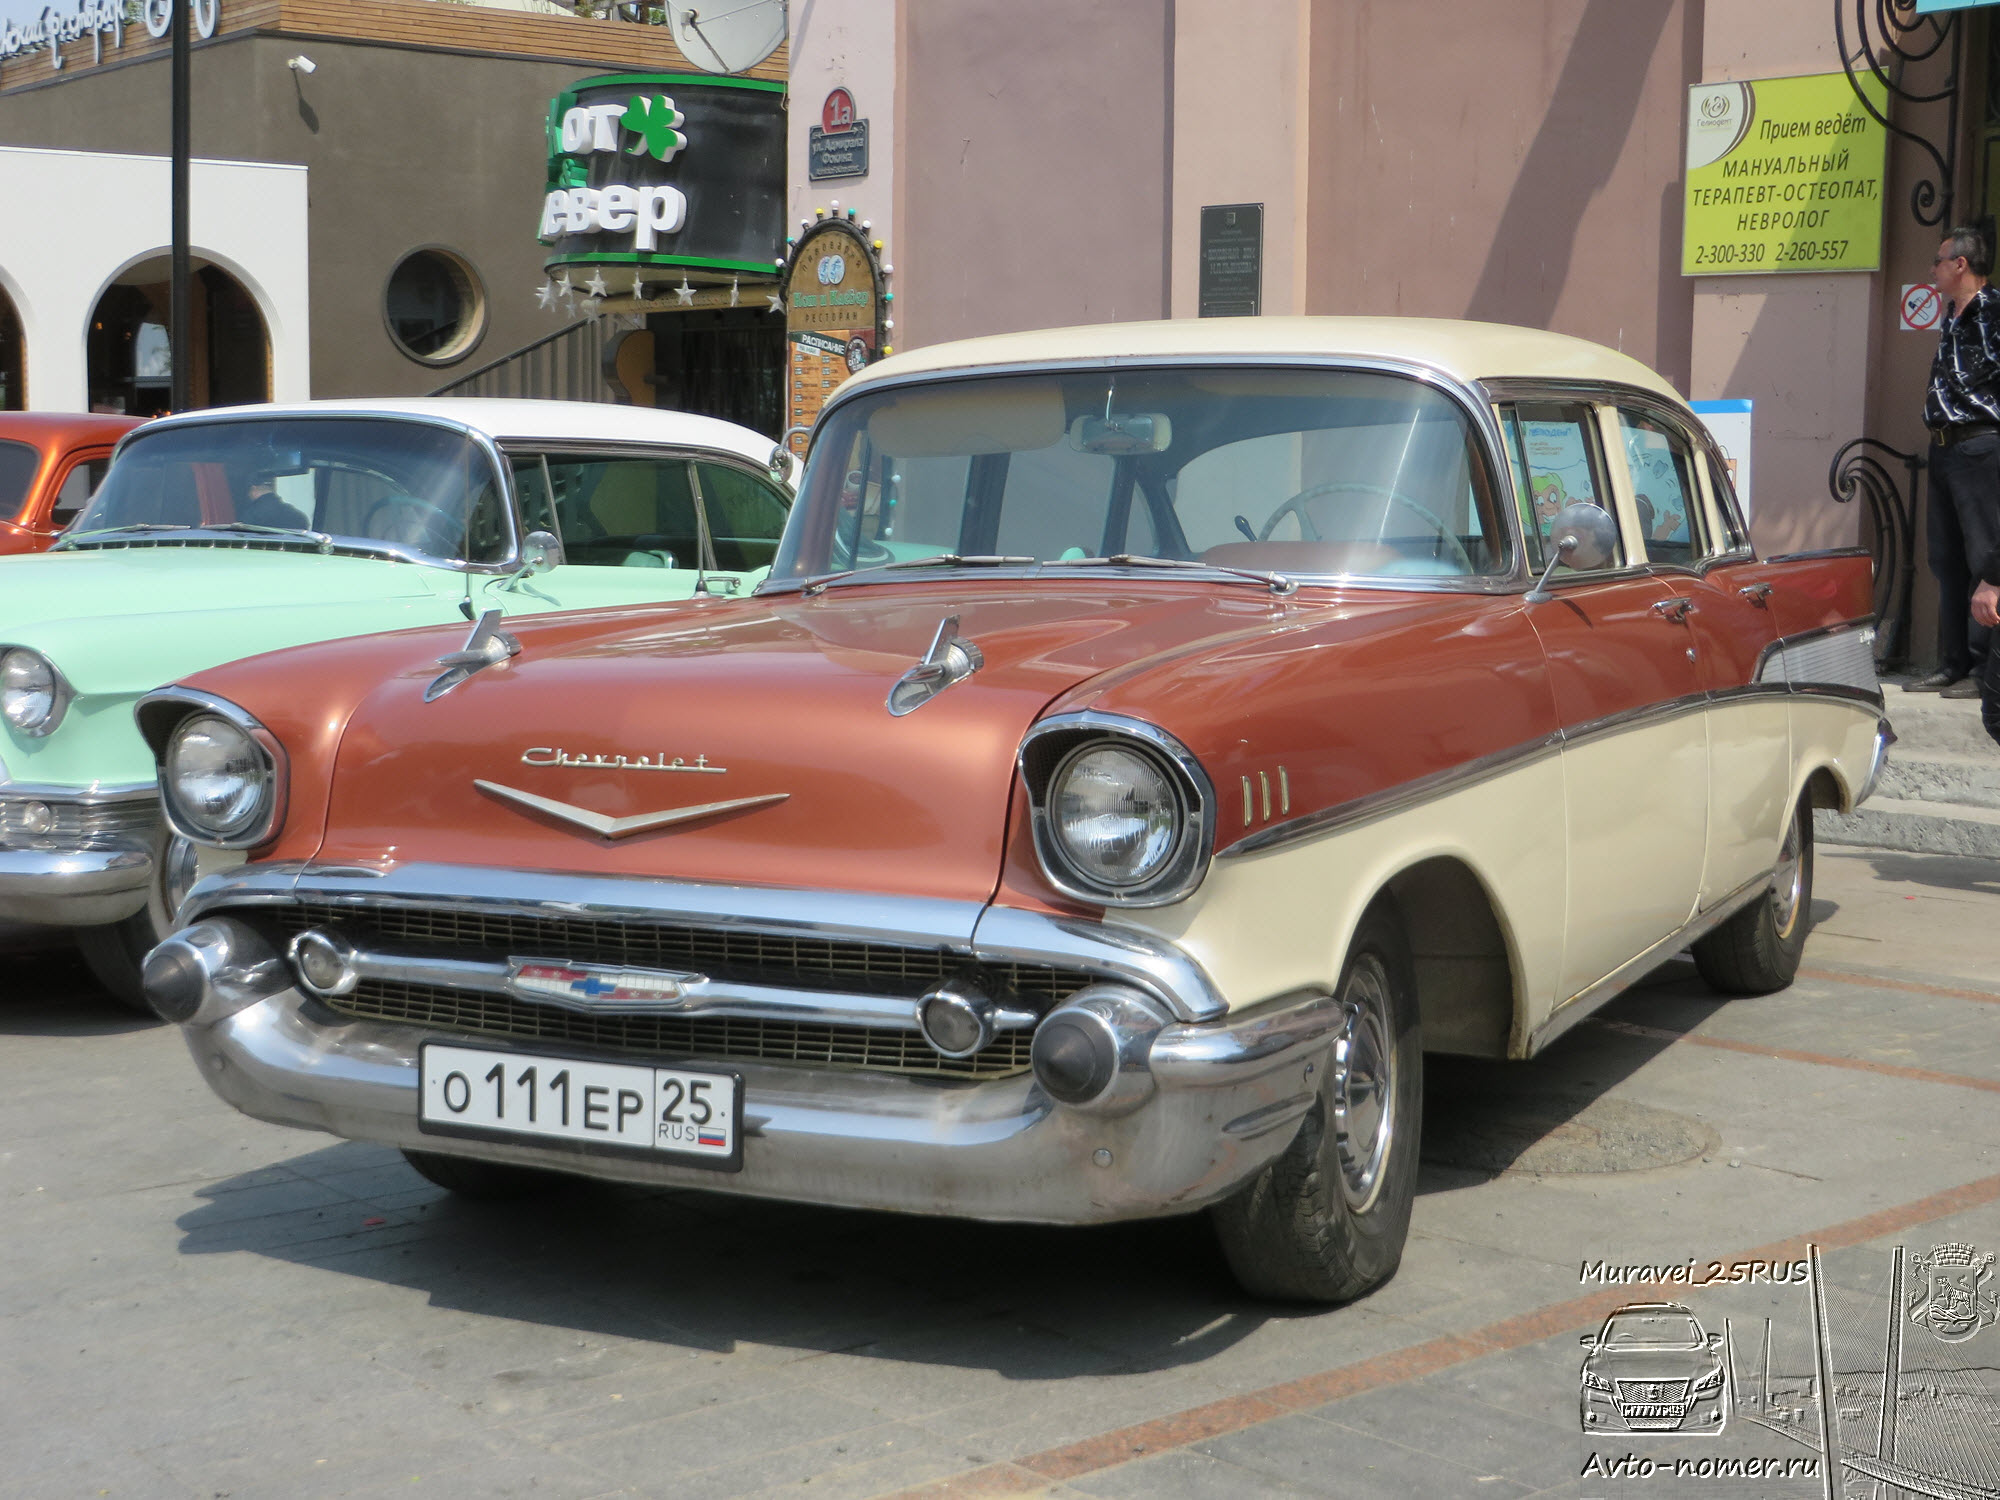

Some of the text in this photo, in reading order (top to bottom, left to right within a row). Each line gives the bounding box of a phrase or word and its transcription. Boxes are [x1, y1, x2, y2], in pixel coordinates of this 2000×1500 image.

[1759, 112, 1867, 144] Прием ведёт
[1722, 148, 1850, 178] МАНУАЛЬНЫЙ
[1693, 178, 1879, 207] ТЕРАПЕВТ-ОСТЕОПАТ,
[1736, 209, 1830, 232] НЕВРОЛОГ
[1695, 240, 1849, 265] 2-300-330 2-260-557
[793, 292, 817, 308] Кот
[820, 294, 827, 307] и
[805, 311, 858, 323] РЕСТОРАН
[802, 334, 845, 355] РАСПИСАНИЕ
[520, 747, 727, 773] Chevrolet
[662, 1077, 713, 1125] 25
[658, 1123, 695, 1142] RUS
